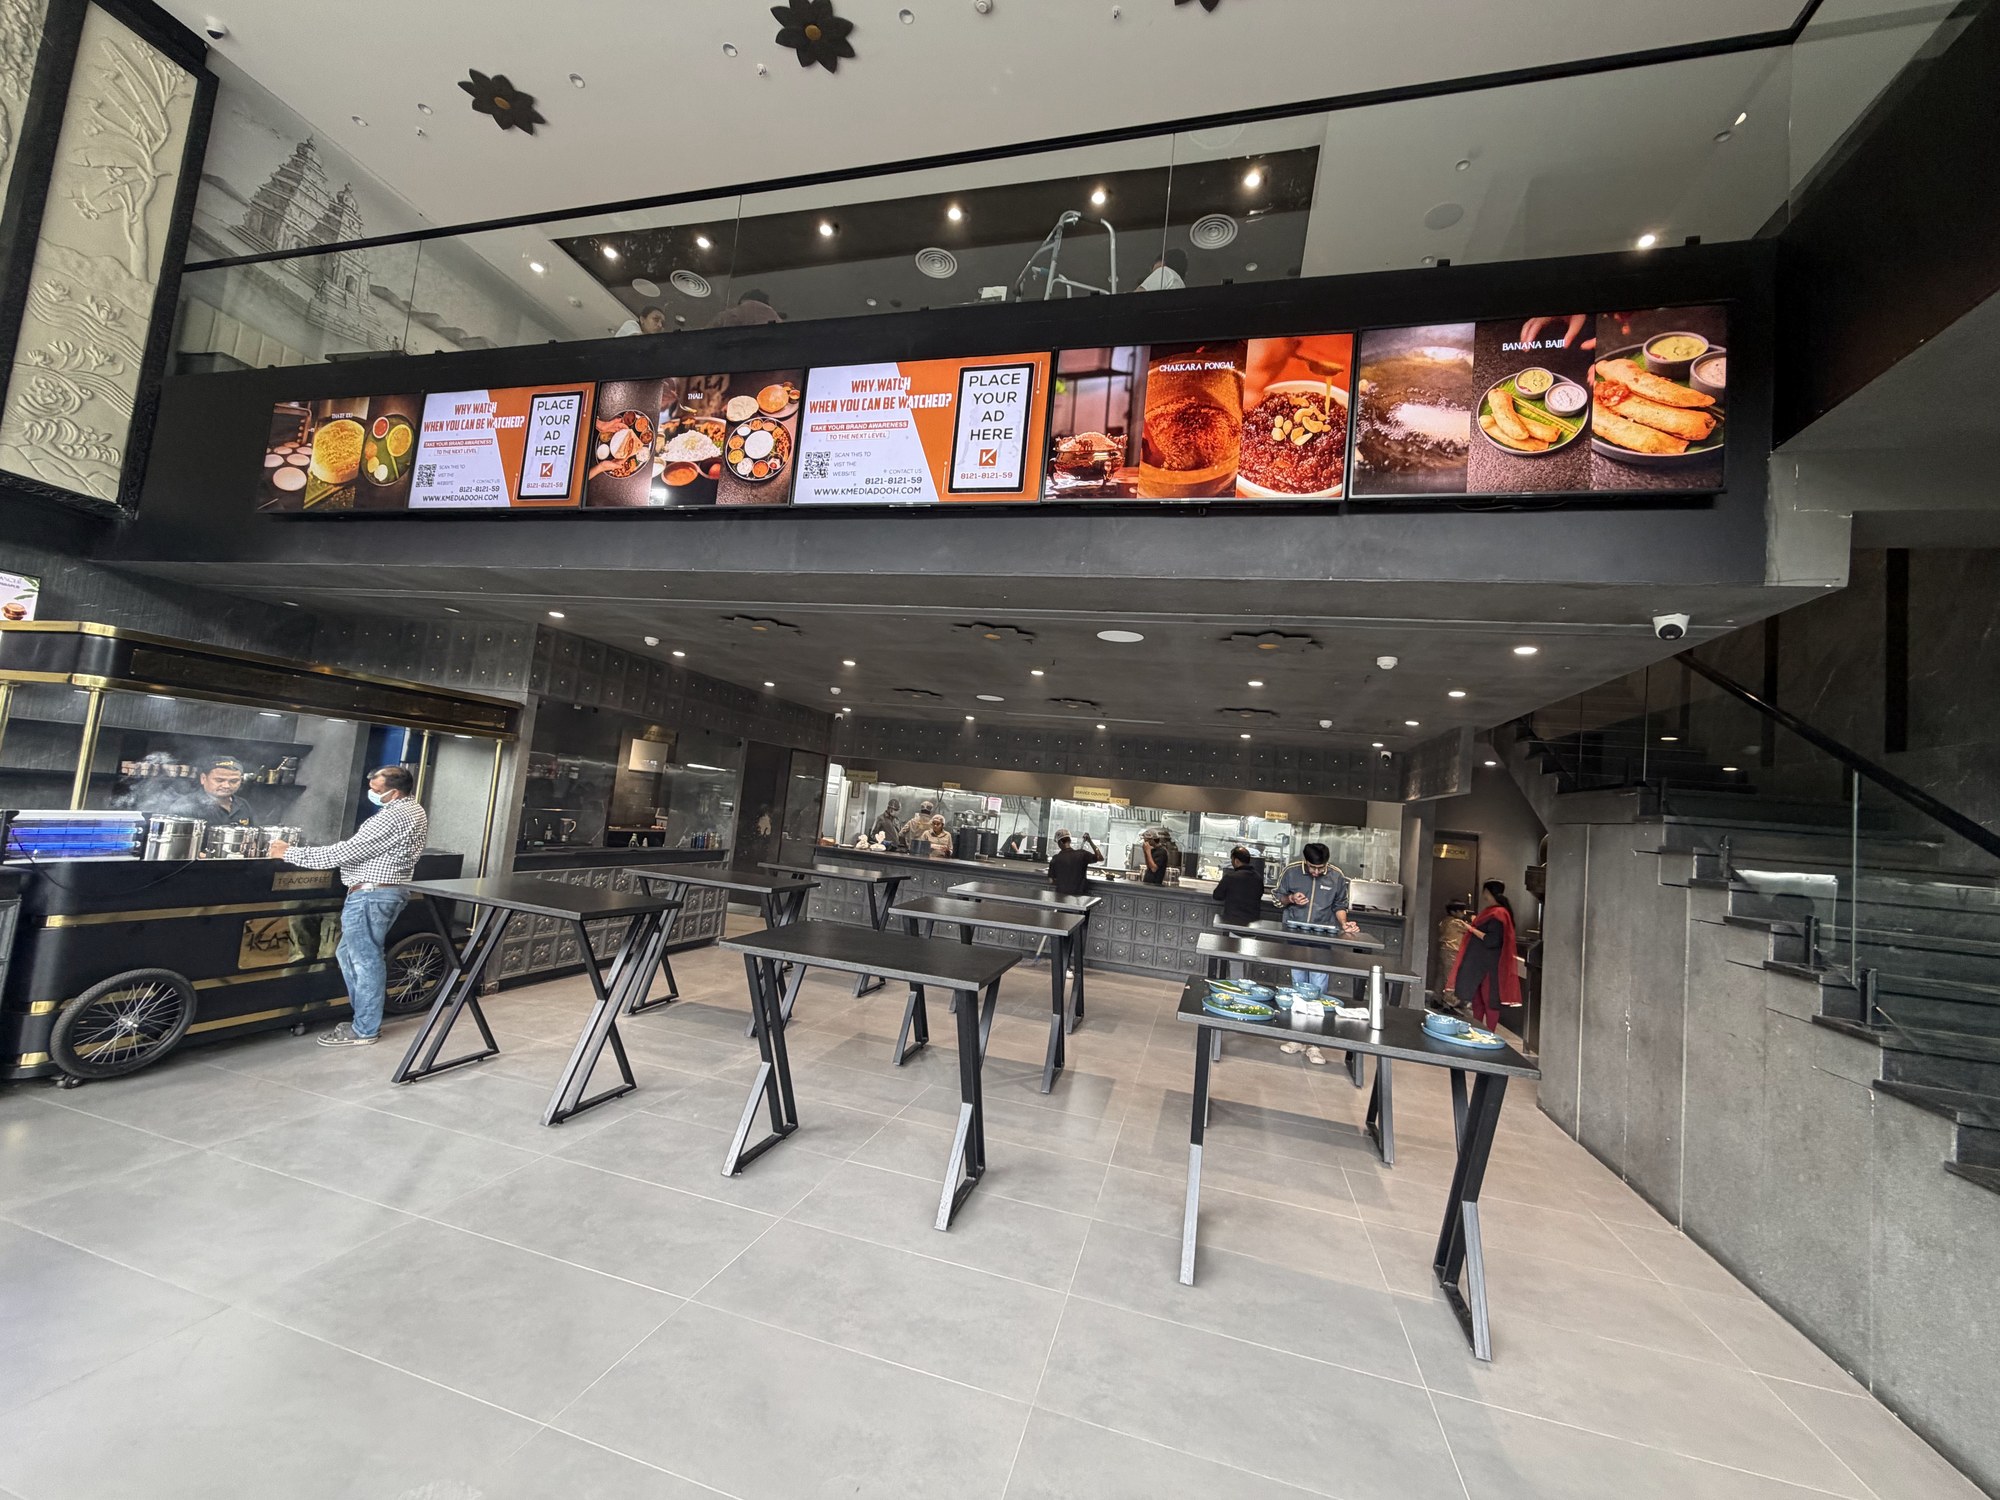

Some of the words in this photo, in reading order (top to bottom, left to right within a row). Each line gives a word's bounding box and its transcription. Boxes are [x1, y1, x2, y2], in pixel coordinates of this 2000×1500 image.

[1502, 341, 1542, 351] BANANA
[1159, 363, 1202, 372] CHAKKARA
[1204, 361, 1235, 370] PONGAL
[851, 379, 875, 393] WHY
[876, 376, 911, 391] WATCH
[969, 373, 1020, 387] PLACE
[809, 400, 837, 414] WHEN
[840, 399, 860, 412] YOU
[861, 398, 880, 411] CAN
[883, 396, 896, 410] BE
[898, 393, 952, 409] WATCHED?
[973, 391, 1017, 405] YOUR
[455, 404, 472, 415] WHY
[473, 402, 497, 414] WATCH
[537, 399, 574, 411] PLACE
[540, 414, 570, 425] YOUR
[981, 410, 1004, 422] AD
[423, 421, 443, 432] WHEN
[445, 420, 459, 431] YOU
[461, 419, 475, 430] CAN
[476, 418, 485, 429] BE
[486, 416, 525, 429] WATCHED?
[868, 421, 907, 429] AWARENESS
[544, 430, 560, 440] AD
[970, 428, 1013, 440] HERE
[535, 445, 565, 456] HERE
[865, 477, 922, 485] 8121-8121-59
[814, 487, 921, 496] WWW.KMEDIADOOH.COM
[422, 494, 498, 502] WWW.KMEDIADOOH.COM
